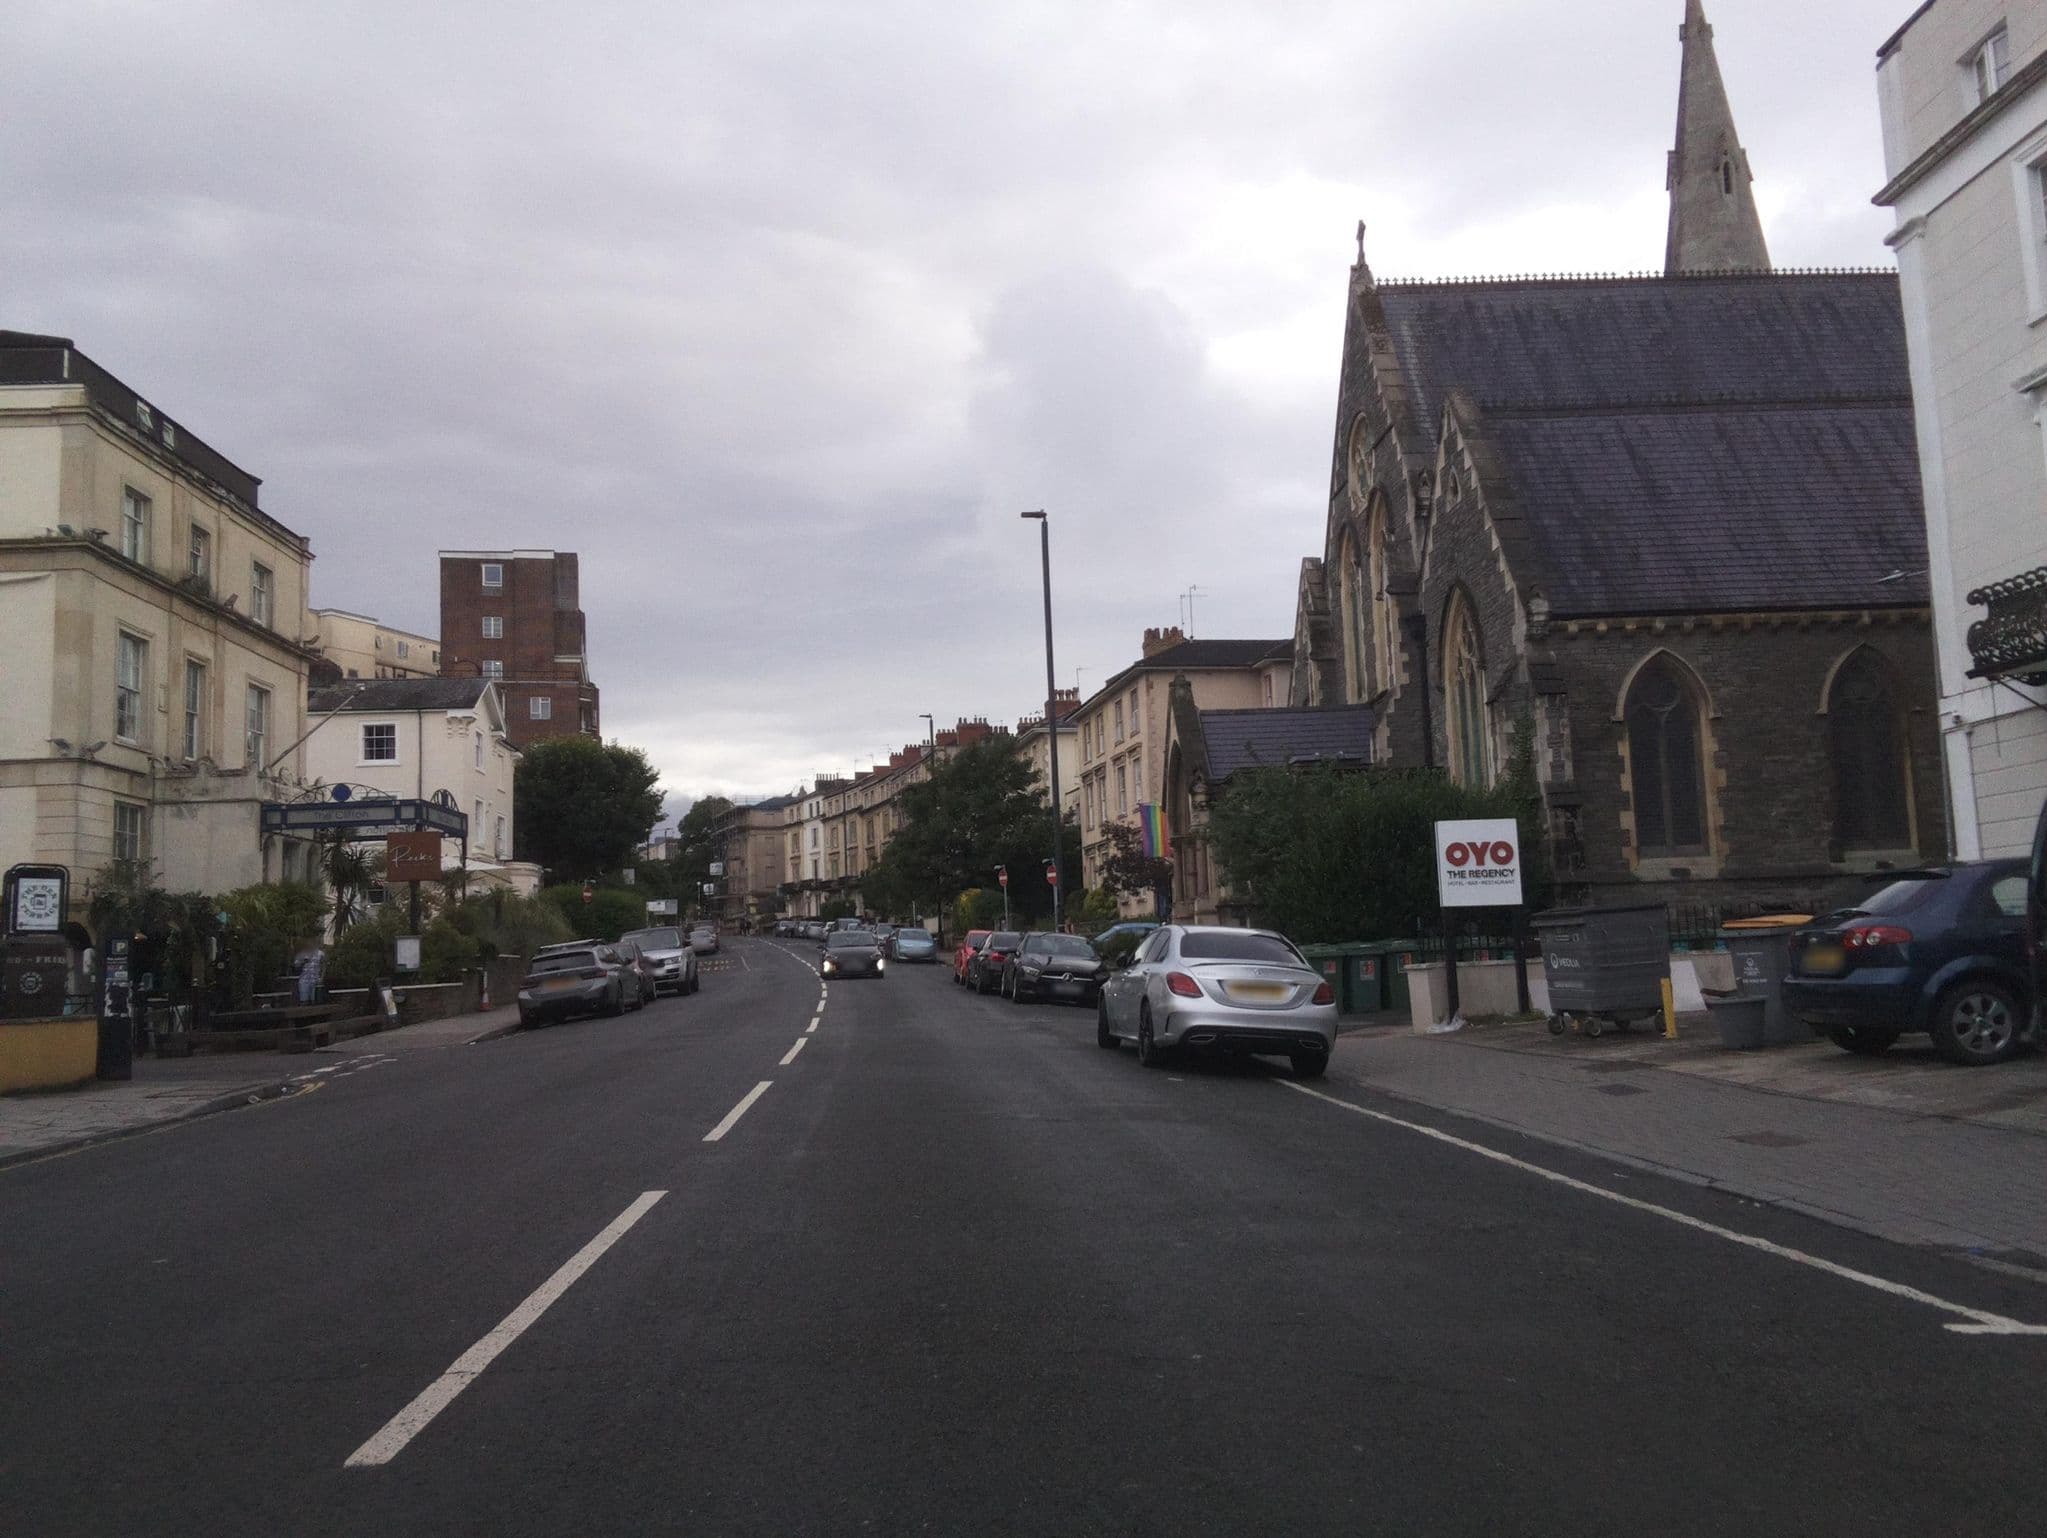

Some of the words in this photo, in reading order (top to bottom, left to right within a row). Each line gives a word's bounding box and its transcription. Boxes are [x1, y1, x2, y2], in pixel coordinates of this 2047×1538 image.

[1445, 841, 1514, 867] OYO
[1447, 870, 1466, 879] THE
[1468, 868, 1515, 878] REGENCY
